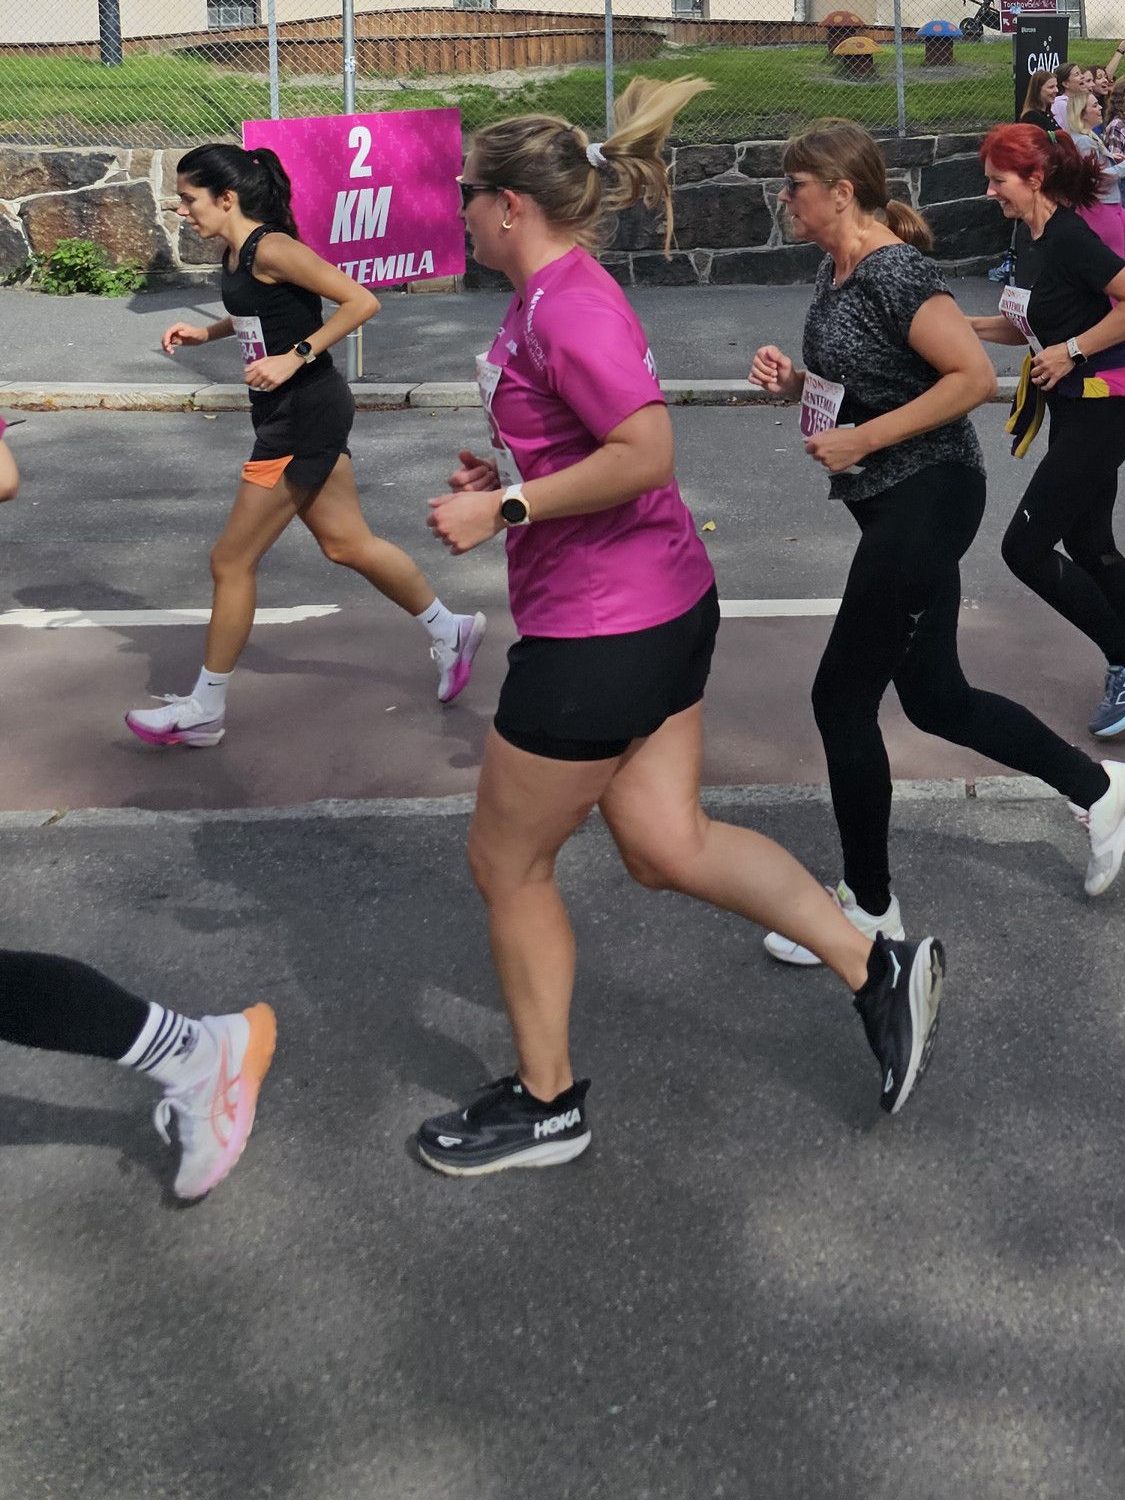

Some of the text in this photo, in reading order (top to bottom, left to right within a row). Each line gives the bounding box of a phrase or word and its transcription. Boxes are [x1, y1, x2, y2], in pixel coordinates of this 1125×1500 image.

[1027, 52, 1060, 76] CAVA
[348, 126, 372, 179] 2
[329, 186, 393, 245] KM
[336, 250, 435, 284] TEMILA
[533, 1107, 581, 1140] HOKA
